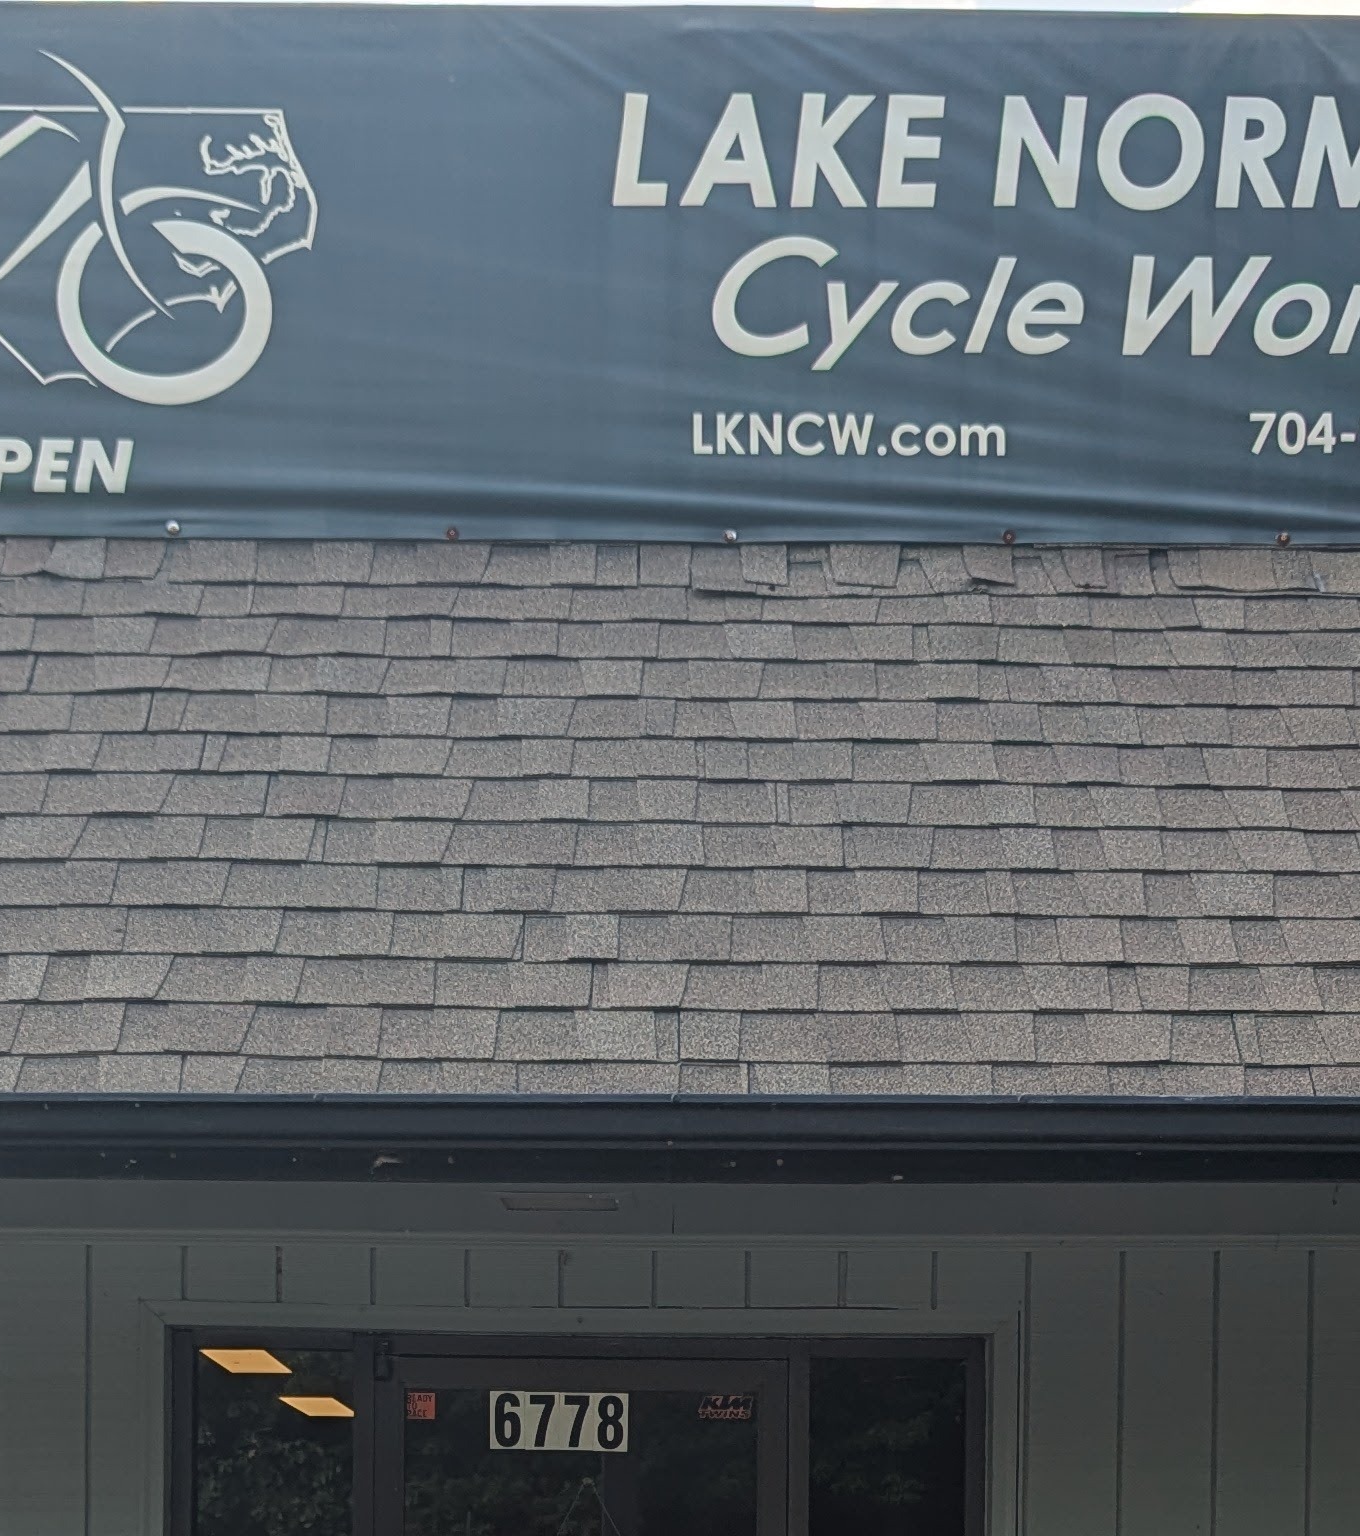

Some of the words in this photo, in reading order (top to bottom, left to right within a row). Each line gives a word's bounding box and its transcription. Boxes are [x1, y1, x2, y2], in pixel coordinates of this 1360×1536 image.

[612, 91, 946, 208] LAKE
[712, 235, 1084, 371] Cycle
[693, 412, 1006, 457] LKNCW.com
[494, 1392, 624, 1450] 6778
